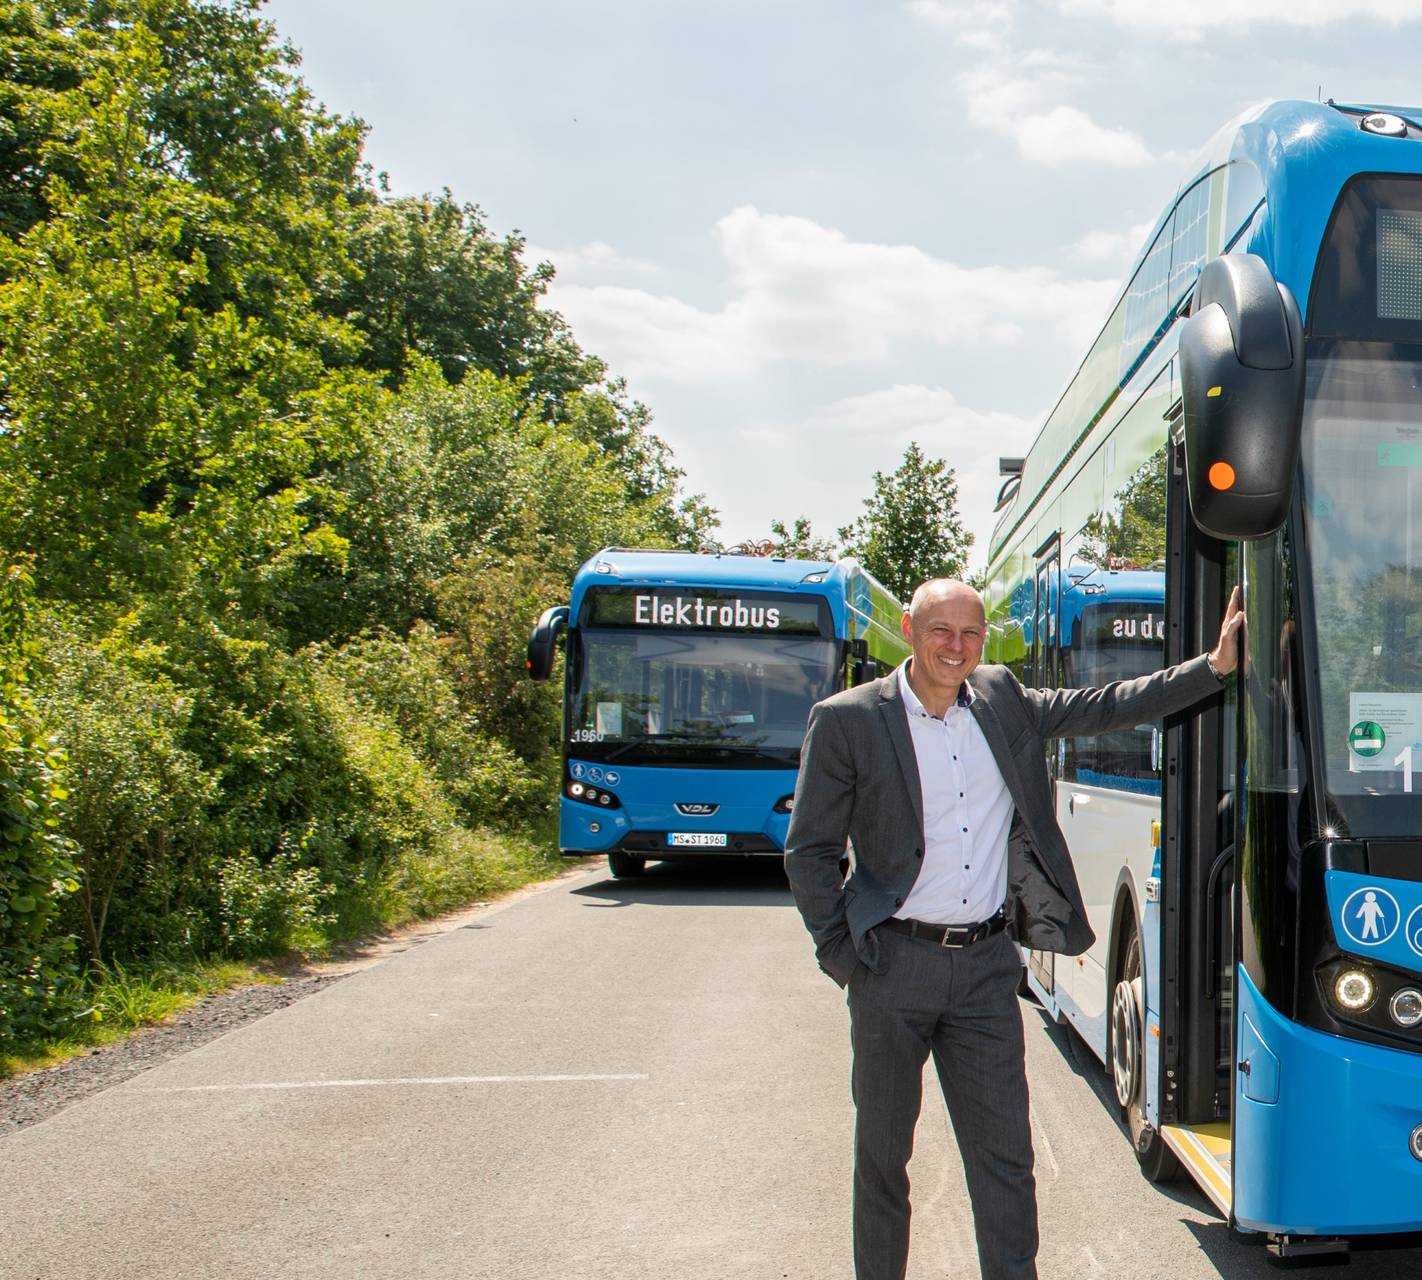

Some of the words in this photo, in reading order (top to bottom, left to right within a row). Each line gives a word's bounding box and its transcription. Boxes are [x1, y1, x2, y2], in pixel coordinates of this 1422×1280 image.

[635, 595, 780, 628] Elektrobus
[574, 729, 604, 742] 1960
[681, 804, 711, 813] VDL
[691, 836, 702, 844] ST
[704, 836, 725, 844] 1960
